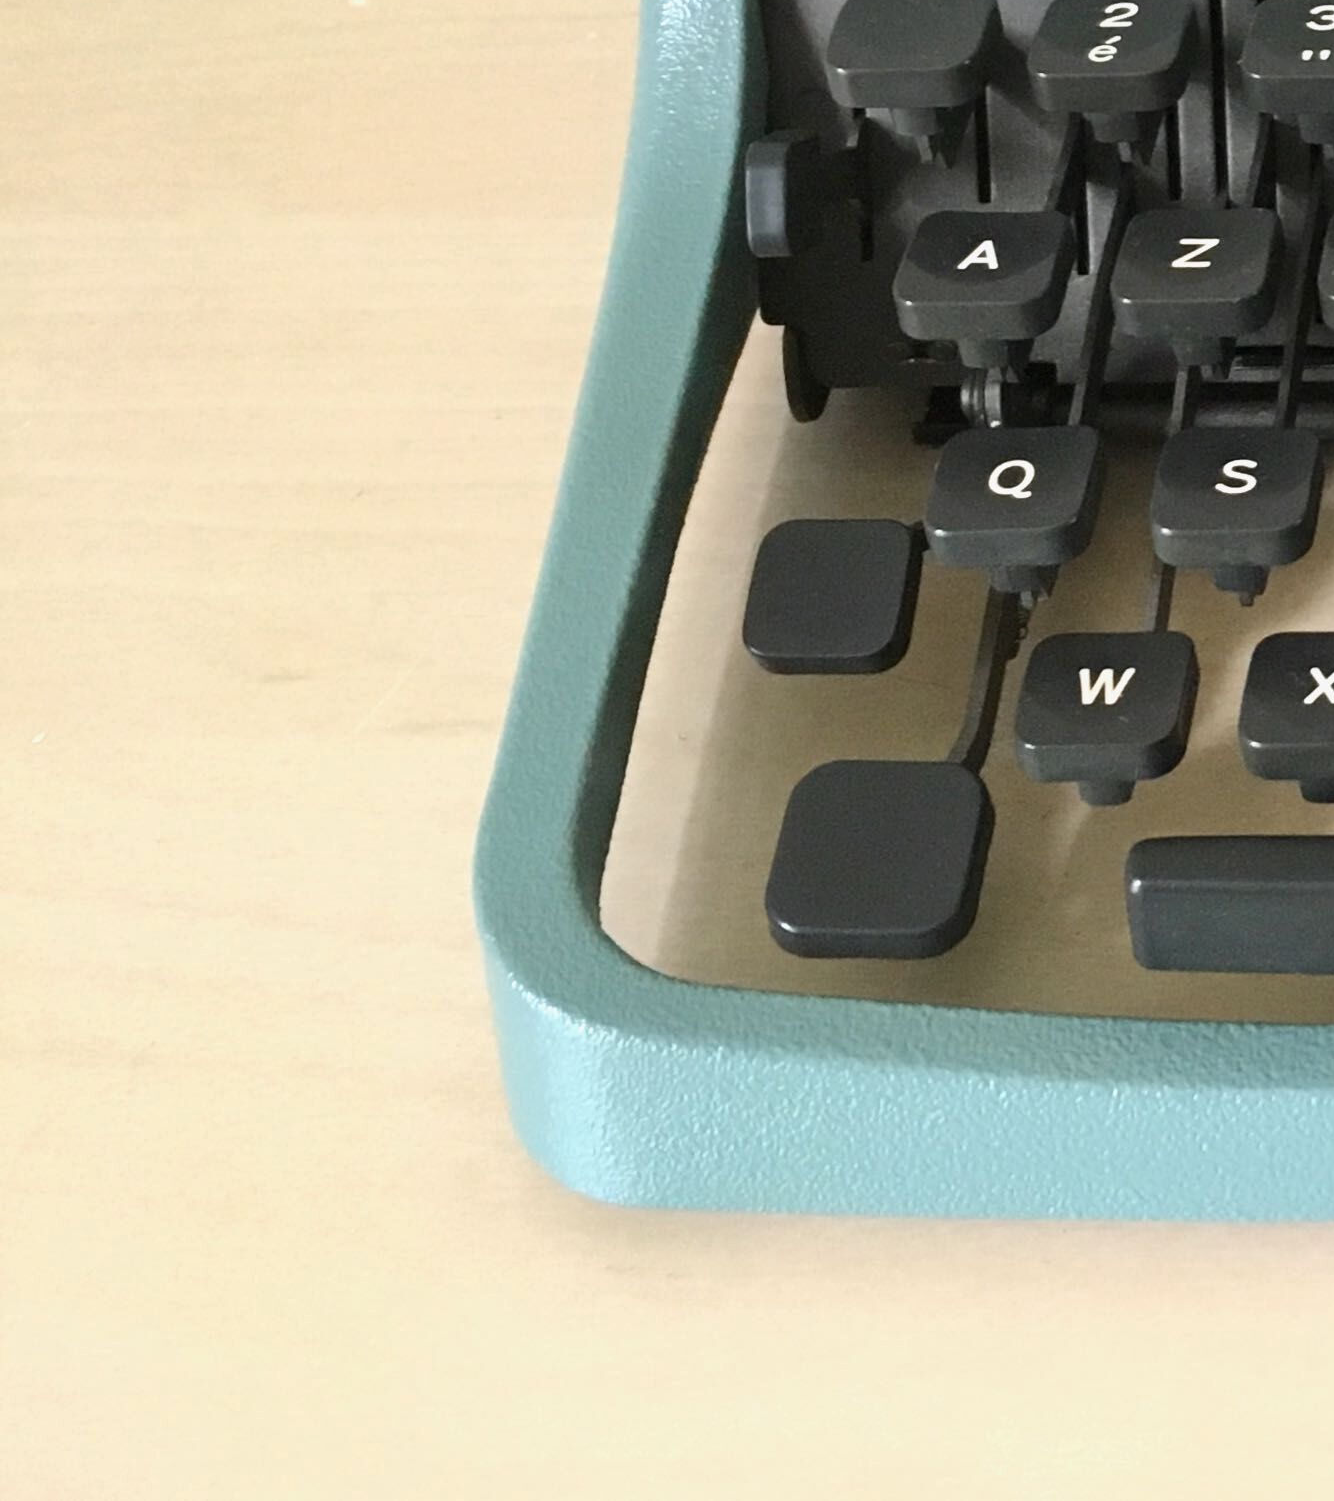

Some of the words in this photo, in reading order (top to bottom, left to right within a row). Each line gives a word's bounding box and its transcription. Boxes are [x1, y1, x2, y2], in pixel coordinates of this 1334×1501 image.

[1098, 2, 1139, 28] 2
[1087, 35, 1122, 63] é
[956, 239, 999, 270] A
[1171, 238, 1220, 268] Z
[988, 459, 1035, 499] Q
[1214, 459, 1258, 495] S
[1078, 667, 1136, 705] W
